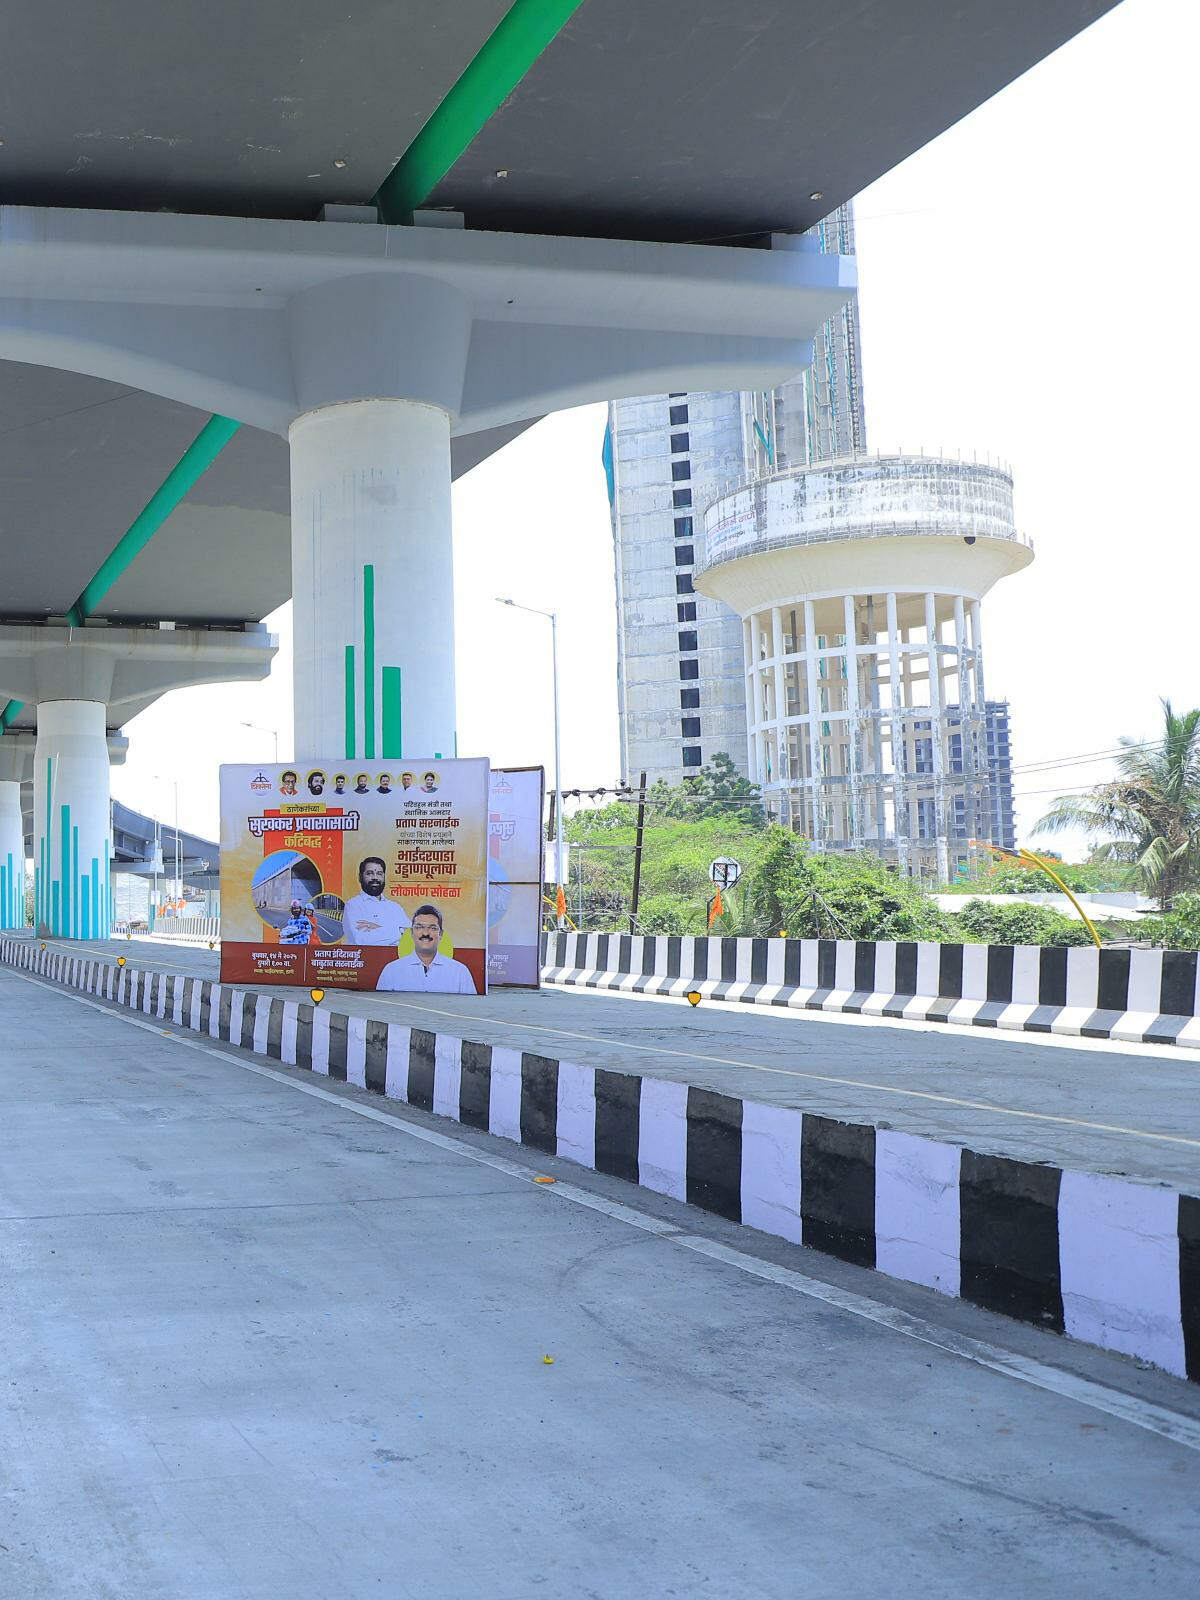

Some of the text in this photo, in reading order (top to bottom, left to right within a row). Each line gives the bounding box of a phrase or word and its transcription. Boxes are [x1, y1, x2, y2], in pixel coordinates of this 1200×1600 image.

[286, 805, 320, 813] ठाणेकरांच्या
[403, 800, 427, 809] परिवहन
[427, 800, 439, 808] मंत्री
[404, 808, 428, 816] स्थानिक
[248, 811, 361, 838] सुखकर प्रवासासाठी
[395, 816, 460, 829] प्रताप सरनाईक
[284, 832, 323, 849] कटिबद्ध
[431, 838, 455, 846] आलेल्या
[397, 847, 455, 863] भाईंदरपाडा
[390, 884, 462, 898] लोकार्पण सोहळा
[314, 950, 331, 958] प्रताप
[311, 958, 364, 969] बाबुराव सरनाईक
